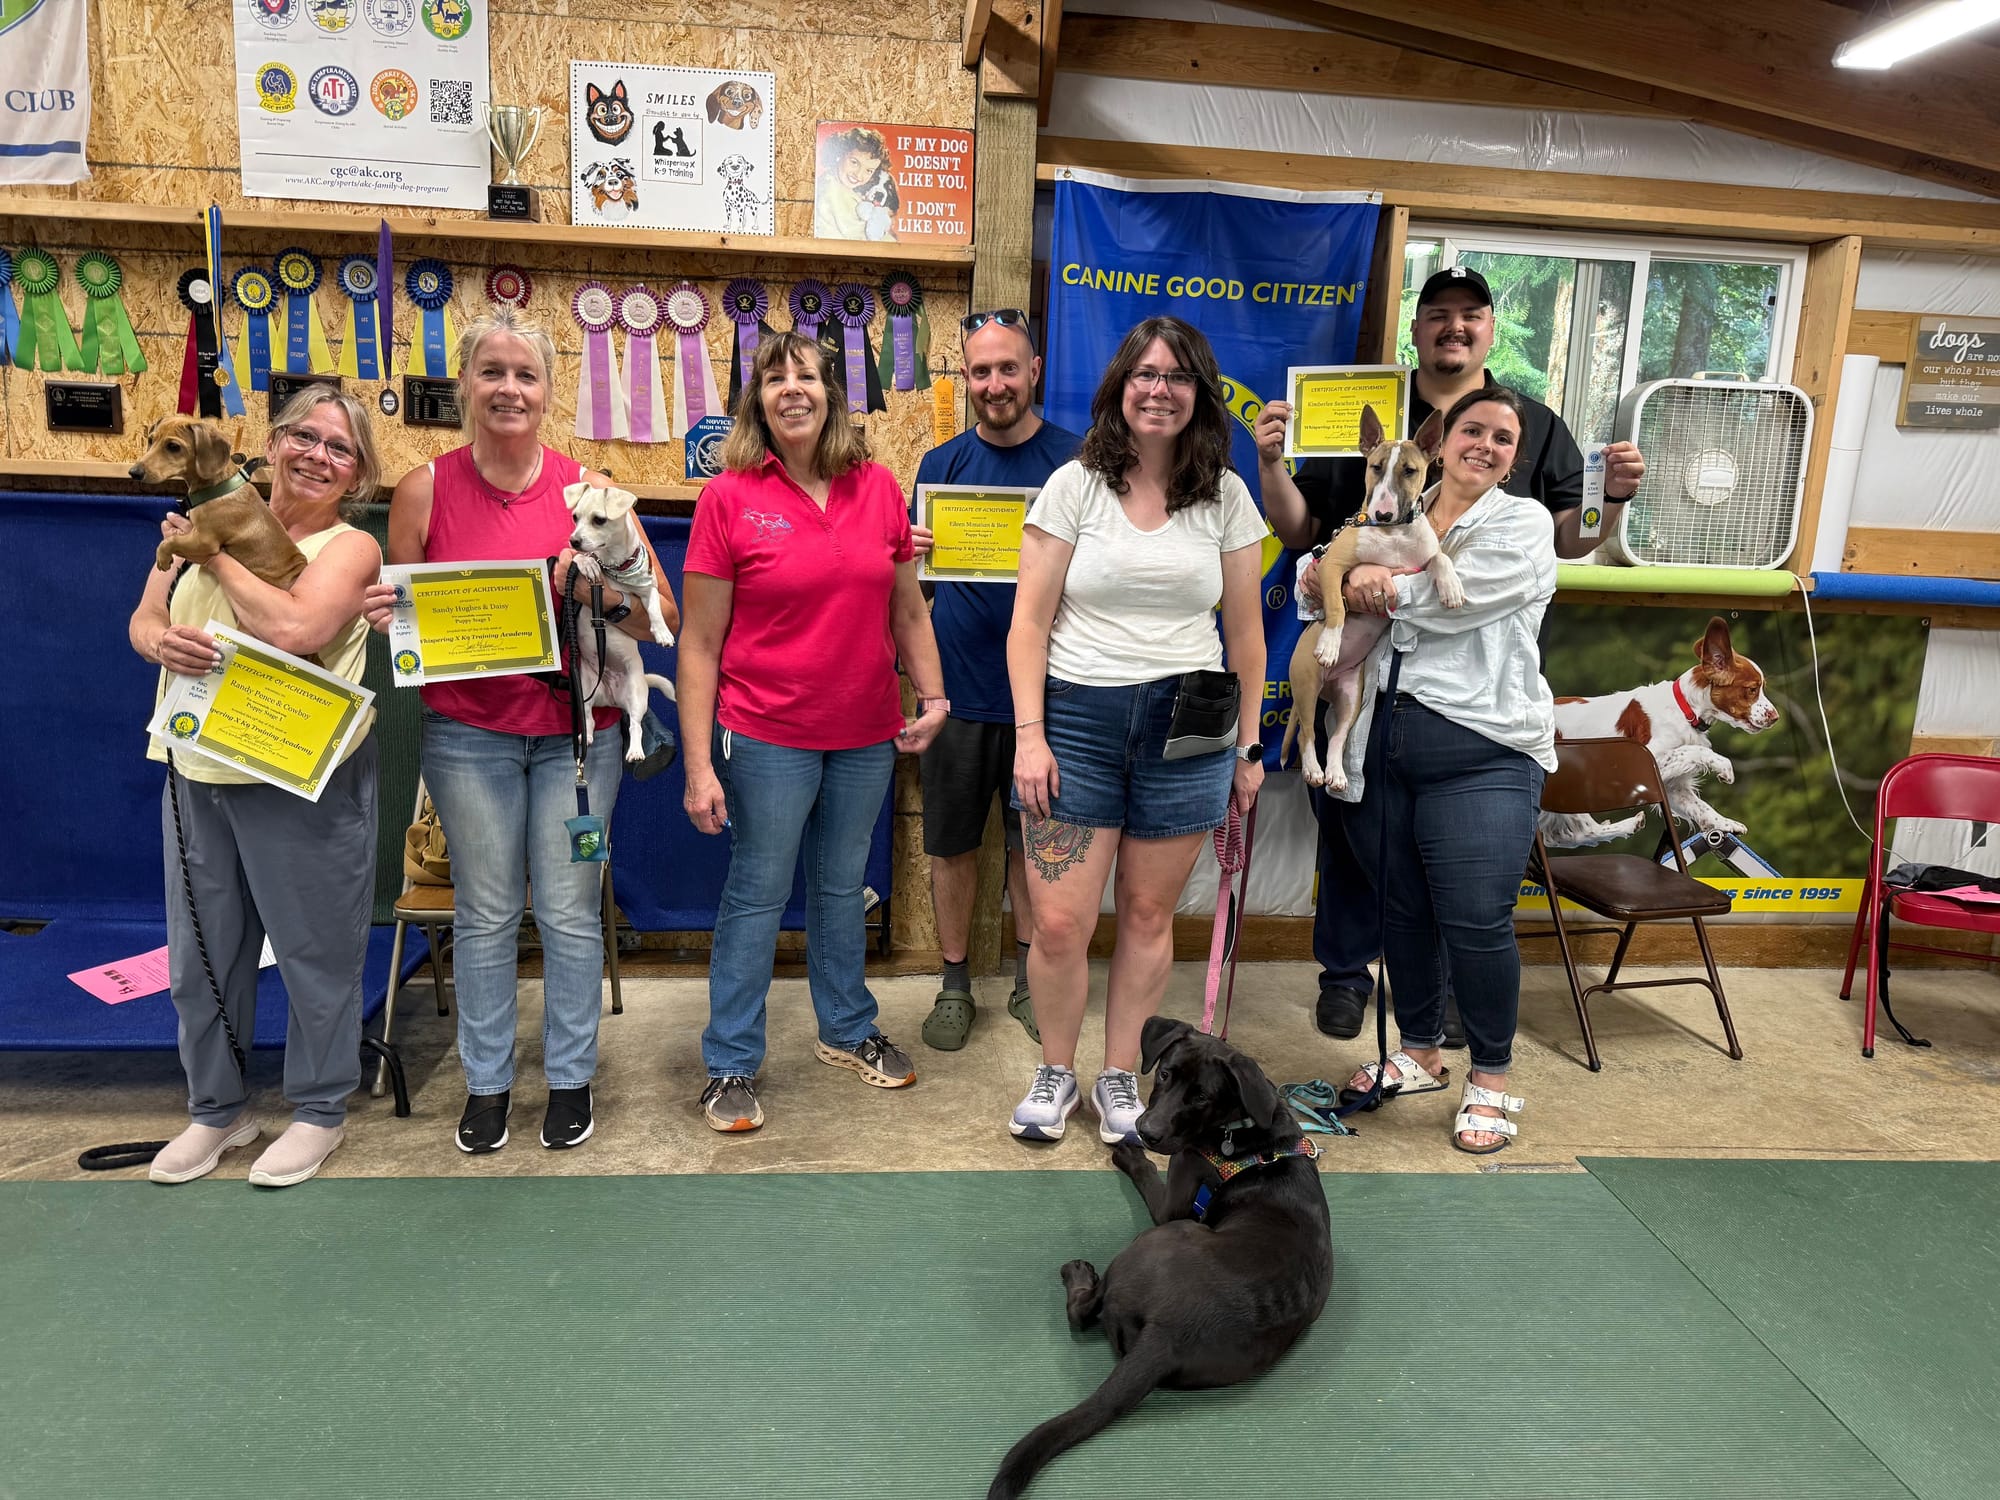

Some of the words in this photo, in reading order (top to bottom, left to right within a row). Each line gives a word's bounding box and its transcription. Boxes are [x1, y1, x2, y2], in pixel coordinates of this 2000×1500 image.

[5, 89, 75, 112] CLUB
[646, 93, 696, 106] SMILES
[897, 136, 912, 151] IF
[915, 137, 937, 152] MY
[940, 139, 968, 154] DOG
[654, 158, 689, 169] Whispering
[904, 155, 961, 171] DOESN'T
[330, 166, 403, 182] cgc@akc.org
[654, 167, 667, 175] K-9
[668, 168, 694, 179] Training
[898, 172, 933, 188] LIKE
[937, 174, 967, 192] YOU,
[907, 201, 913, 215] I
[916, 201, 956, 217] DON'T
[898, 218, 933, 234] LIKE
[936, 220, 967, 235] YOU.
[1062, 263, 1160, 296] CANINE
[1166, 275, 1244, 301] GOOD
[1929, 321, 1986, 364] dogs
[1967, 353, 1984, 361] are
[1987, 354, 2000, 362] no
[1923, 366, 1941, 374] our
[1944, 365, 1972, 375] whole
[1975, 366, 2000, 377] lives
[1935, 392, 1958, 401] make
[1962, 393, 1980, 402] our
[1925, 405, 1952, 415] lives
[1956, 407, 1983, 417] whole
[416, 588, 461, 598] CERTIFICATE
[473, 585, 520, 593] ACHIEVEMENT
[432, 606, 454, 615] Sandy
[455, 604, 481, 613] Hughes
[490, 603, 509, 611] Daisy
[472, 633, 499, 641] Training
[500, 630, 533, 639] Academy
[230, 680, 253, 695] Randy
[254, 689, 277, 705] Pence
[283, 703, 311, 721] Cowboy
[275, 679, 286, 687] OF
[285, 684, 333, 708] ACHIEVEMENT
[251, 723, 280, 741] Training
[280, 737, 313, 756] Academy
[1743, 886, 1793, 900] since
[1799, 887, 1842, 900] 1995
